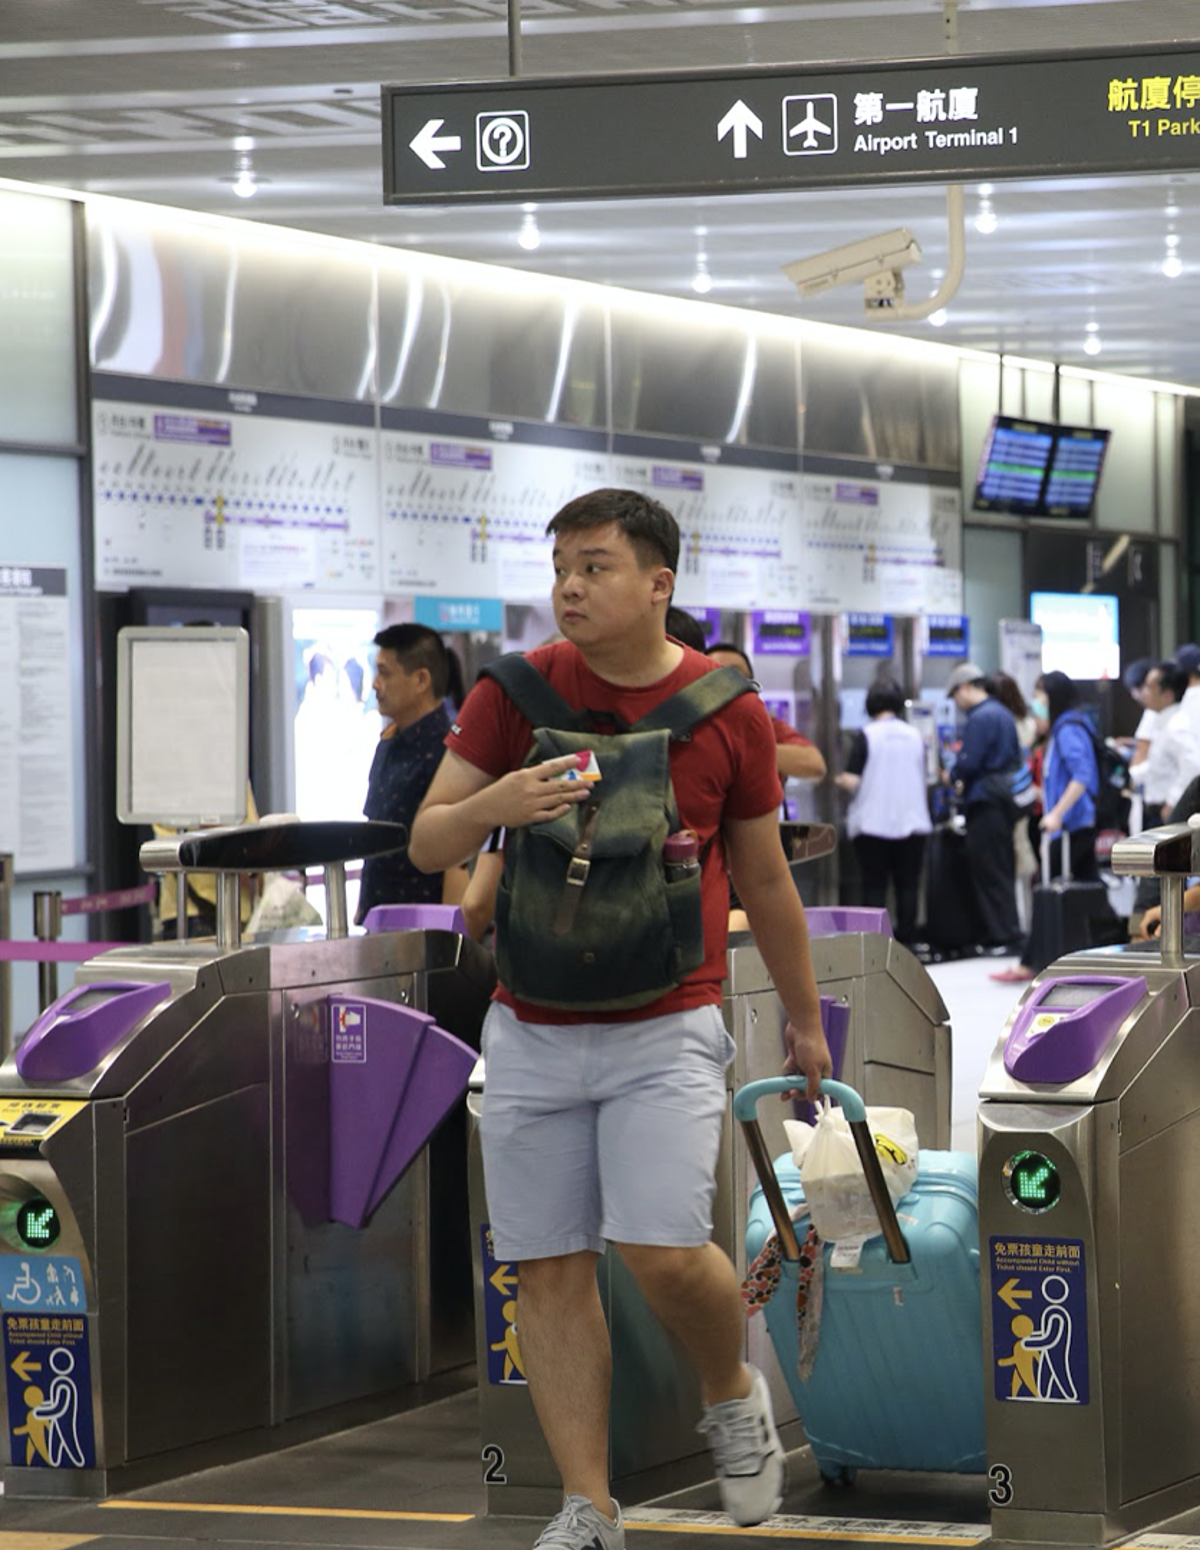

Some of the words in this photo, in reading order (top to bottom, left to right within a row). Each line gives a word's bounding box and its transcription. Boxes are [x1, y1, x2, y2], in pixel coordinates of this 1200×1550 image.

[854, 87, 978, 125] 第一航廈
[854, 133, 918, 155] Airport
[925, 128, 1004, 149] Terminal
[1009, 127, 1018, 144] 1
[1128, 119, 1150, 138] T1
[995, 1243, 1080, 1257] 免票孩童走前面
[482, 1444, 507, 1485] 2
[988, 1463, 1014, 1506] 3
